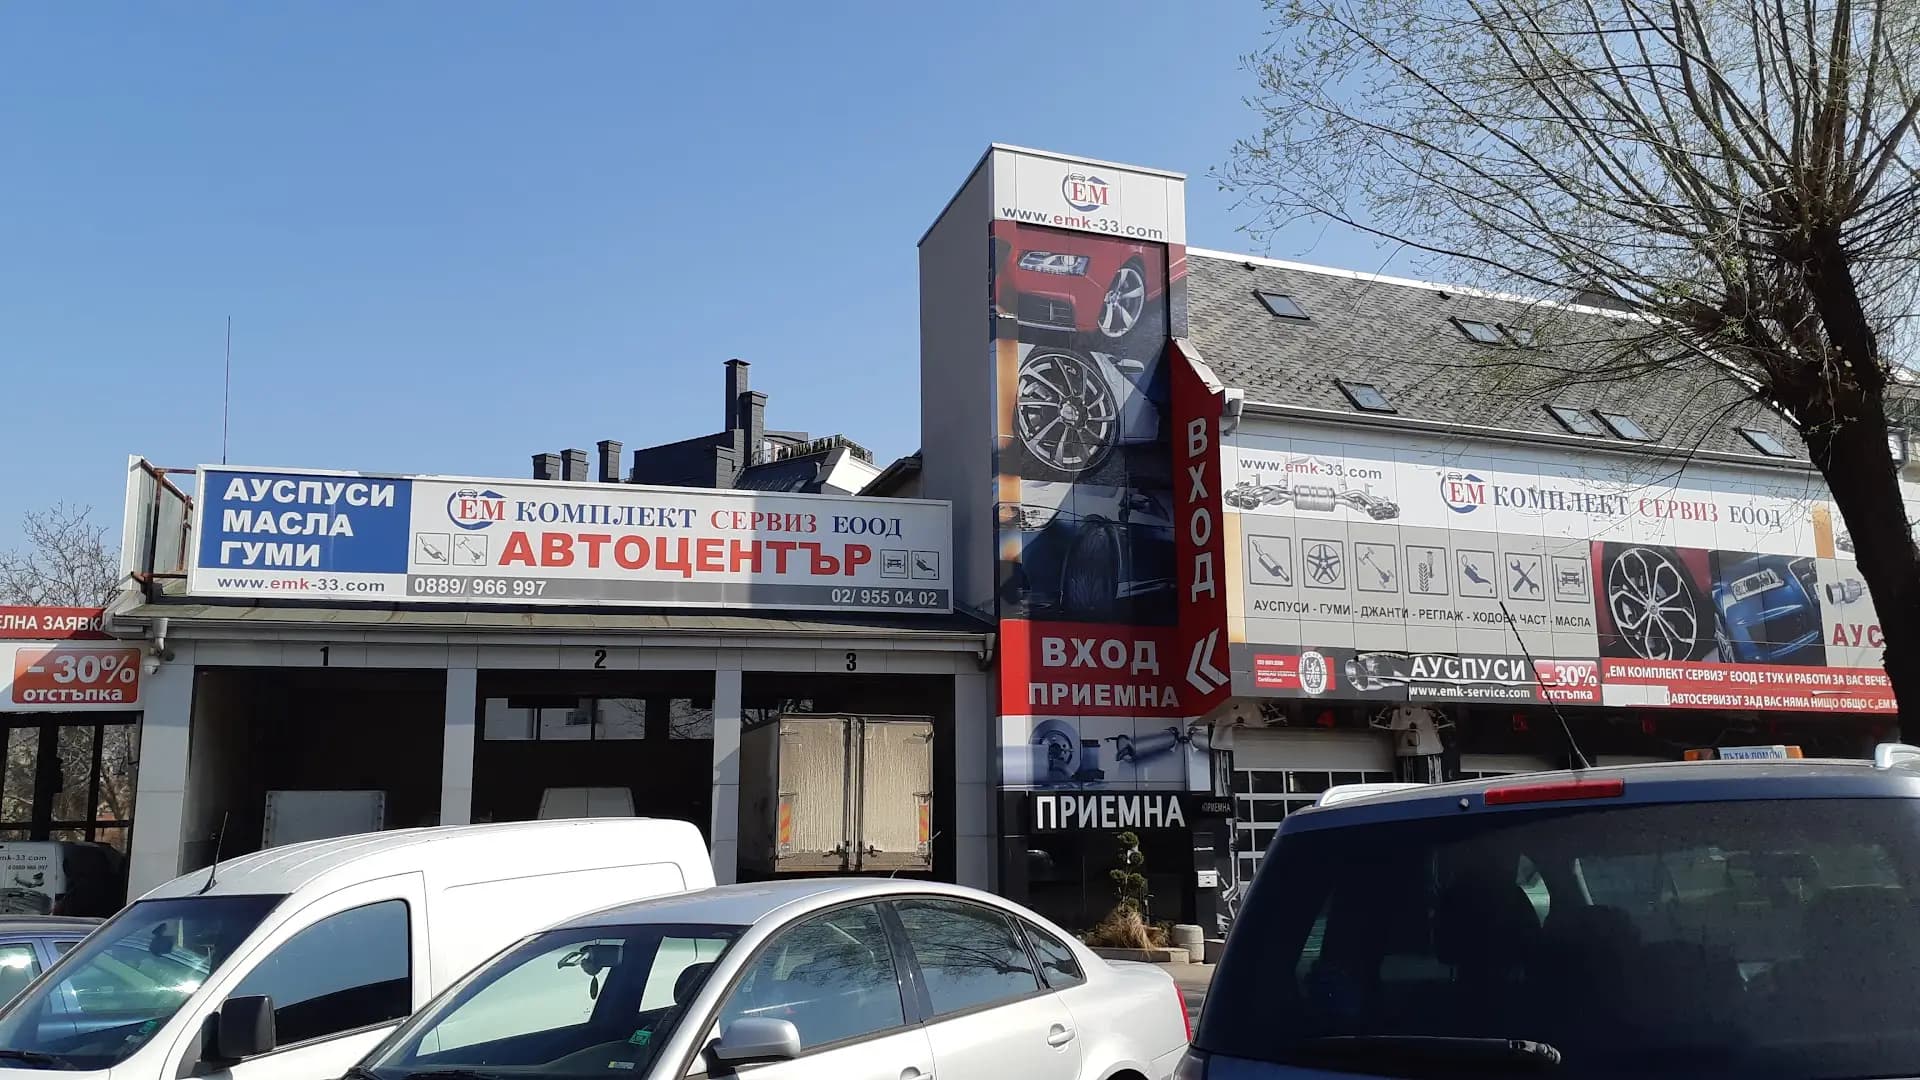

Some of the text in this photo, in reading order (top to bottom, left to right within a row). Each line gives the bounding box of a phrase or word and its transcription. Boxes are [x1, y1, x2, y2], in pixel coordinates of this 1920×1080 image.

[1071, 182, 1109, 206] ЕМ
[1002, 207, 1163, 239] www.emk-33.com
[1239, 457, 1382, 480] www.emk-33.com
[223, 477, 395, 508] АУСПУСИ
[1187, 417, 1215, 604] ВХОД
[1449, 482, 1782, 528] ЕМ КОМПЛЕКТ СЕРВИЗ ЕООД
[222, 510, 354, 538] МАСЛА
[457, 499, 903, 538] ЕМ КОМПЛЕКТ СЕРВИЗ ЕООД
[220, 541, 321, 568] ГУМИ
[498, 531, 872, 579] АВТОЦЕНТЪР
[217, 576, 385, 593] www.emk-33.com
[414, 579, 547, 596] 0889/ 966 997
[831, 588, 938, 606] 02/ 955 04 02
[1254, 600, 1310, 614] АУСПУСИ
[1320, 603, 1351, 616] ГУМИ
[1360, 606, 1409, 619] ДЖАНТИ
[1419, 609, 1464, 621] РЕГЛАЖ
[1473, 611, 1517, 625] ХОДОВА
[1519, 613, 1546, 625] ЧАСТ
[1555, 615, 1591, 627] МАСЛА
[321, 648, 329, 666] 1
[594, 649, 607, 669] 2
[845, 651, 857, 671] 3
[1041, 637, 1160, 675] ВХОД
[53, 655, 136, 684] 30%
[1410, 656, 1526, 681] АУСПУСИ
[1555, 666, 1597, 687] 30%
[1628, 666, 1684, 680] КОМПЛЕКТ
[1730, 671, 1758, 684] ЕООД
[1759, 672, 1764, 683] Е
[1765, 673, 1784, 684] ТУК
[1785, 673, 1793, 684] И
[1795, 673, 1831, 685] РАБОТИ
[1832, 675, 1844, 685] ЗА
[1846, 675, 1864, 686] ВАС
[1865, 676, 1887, 686] ВЕЧЕ
[23, 688, 123, 701] отстъпка
[1028, 682, 1180, 708] ПРИЕМНА
[1409, 686, 1530, 698] www.emk-service.com
[1542, 689, 1593, 700] отстъпка
[1671, 694, 1742, 706] АВТОСЕРВИЗЪТ
[1744, 695, 1763, 708] ЗАД
[1764, 696, 1782, 707] ВАС
[1783, 697, 1809, 708] НЯМА
[1811, 698, 1839, 710] НИЩО
[1841, 698, 1866, 710] ОБЩО
[1036, 795, 1186, 829] ПРИЕМНА
